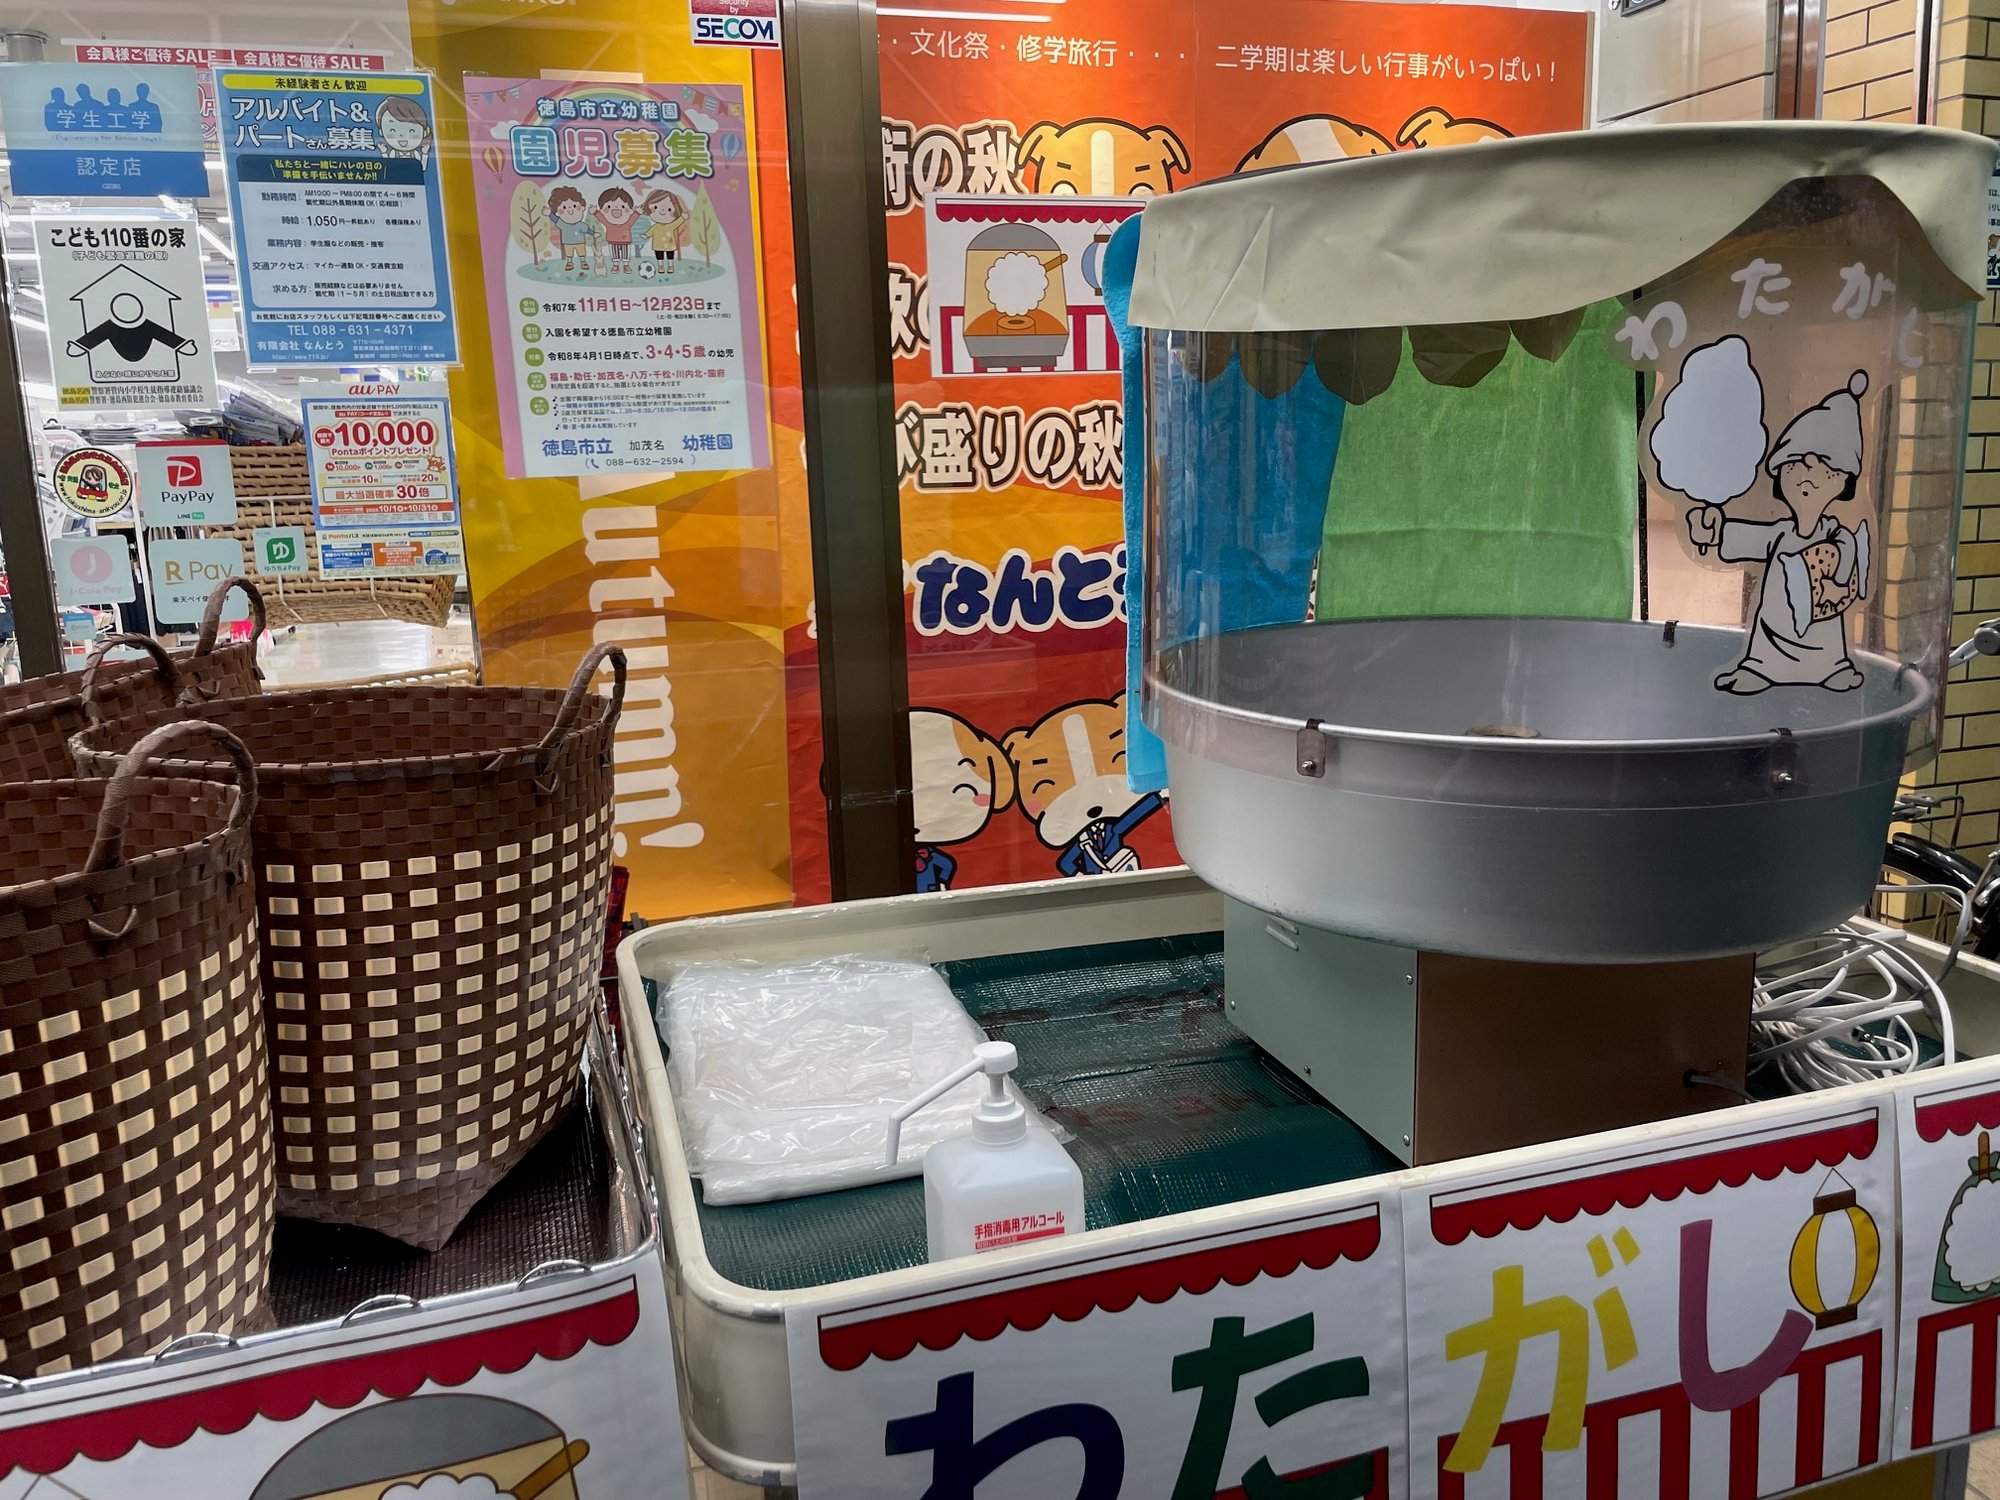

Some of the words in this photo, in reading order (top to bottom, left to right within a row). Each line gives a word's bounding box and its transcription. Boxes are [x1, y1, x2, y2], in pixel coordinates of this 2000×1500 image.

[729, 6, 739, 14] by
[696, 17, 774, 40] SECOM
[86, 46, 172, 62] 会員様ご優待
[175, 49, 217, 64] SALE
[243, 52, 326, 69] 会員様ご優待
[330, 56, 370, 70] SALE
[275, 77, 342, 90] 未経験者さん
[345, 79, 368, 91] 歓迎
[231, 97, 372, 123] アルバイト&
[536, 99, 679, 120] 徳島市立幼稚園
[57, 110, 151, 129] 学生工学
[234, 125, 376, 150] パートさん募集
[510, 126, 714, 179] 園児募集
[76, 157, 141, 176] 認定店
[51, 227, 186, 248] こども110番の家
[288, 324, 308, 335] TEL
[545, 326, 672, 338] 入園を希望する徳島市立幼稚園
[257, 341, 300, 351] 有限会社
[304, 341, 344, 350] なんとう
[349, 385, 376, 395] au
[377, 385, 400, 395] PAY
[335, 421, 434, 447] 10,000
[332, 446, 431, 456] Pontaポイントプレゼント!
[542, 438, 613, 456] 徳島市立
[629, 439, 665, 451] 加茂名
[682, 434, 734, 451] 幼稚園
[161, 491, 214, 504] PayPay
[916, 552, 1128, 629] なんと
[975, 1211, 1065, 1239] 手指消毒用アルコール
